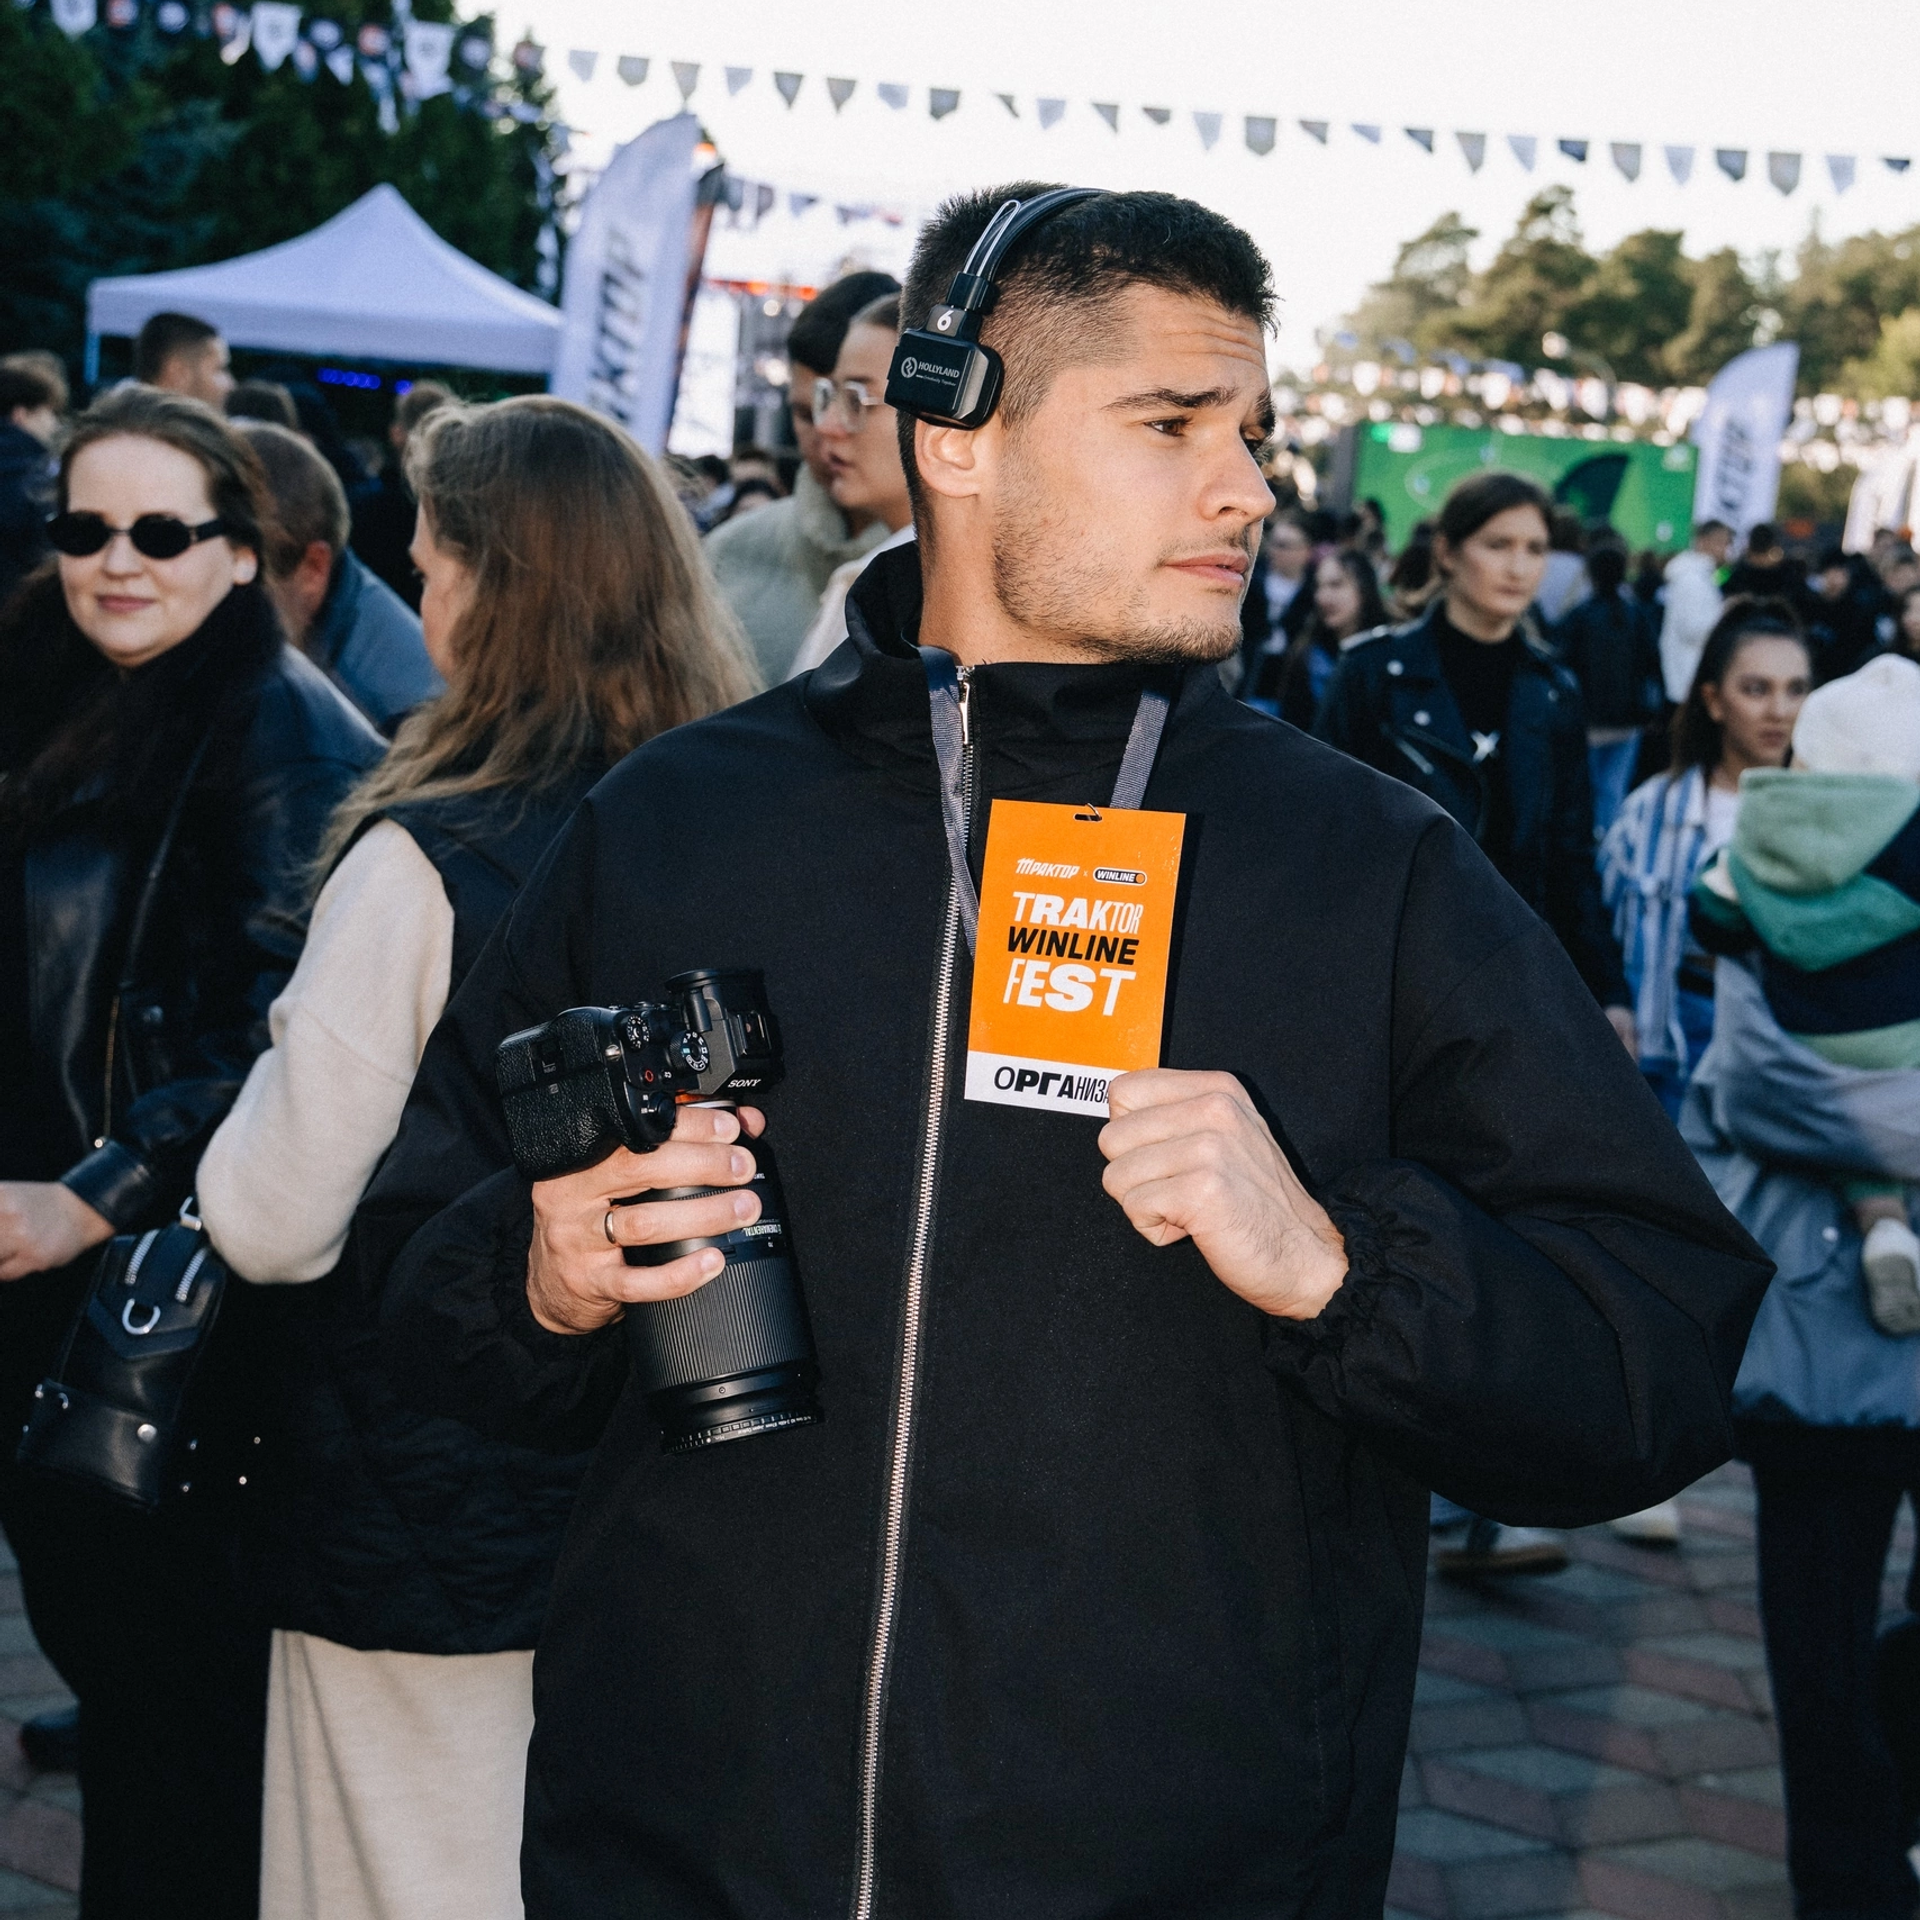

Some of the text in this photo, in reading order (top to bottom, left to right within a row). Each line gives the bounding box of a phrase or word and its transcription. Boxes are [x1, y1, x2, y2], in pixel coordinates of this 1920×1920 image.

[937, 310, 954, 331] 6
[918, 361, 960, 378] HOLLYLAND
[1097, 870, 1136, 882] WINLINE
[1013, 891, 1144, 934] TRAKTOR
[1007, 926, 1139, 965] WINLINE
[1003, 958, 1136, 1017] FEST
[727, 1079, 762, 1088] SONY
